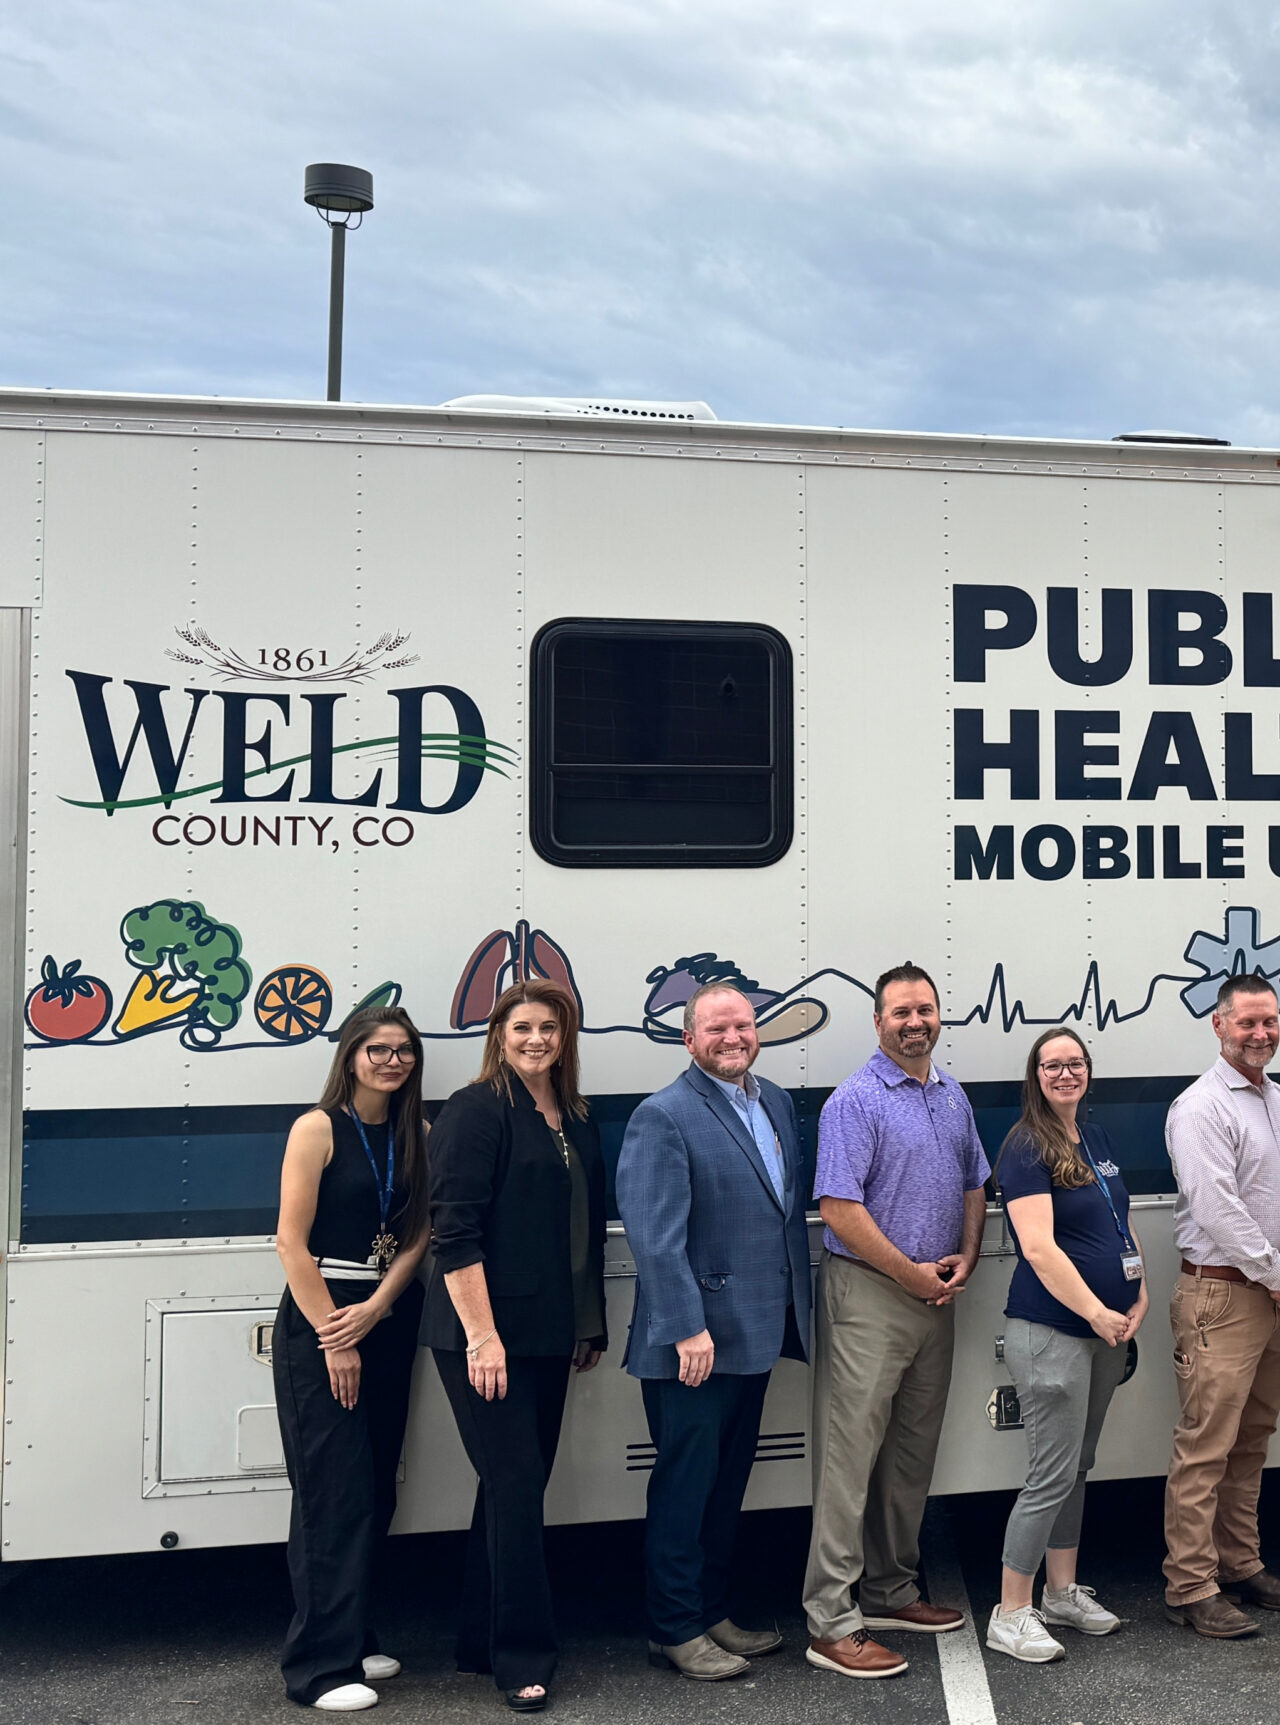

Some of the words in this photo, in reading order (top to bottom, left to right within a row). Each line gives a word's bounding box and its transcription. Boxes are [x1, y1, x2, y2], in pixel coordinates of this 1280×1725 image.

[258, 647, 329, 672] 1861
[65, 669, 487, 817] WELD
[152, 815, 341, 853] COUNTY,
[352, 815, 415, 847] CO
[954, 824, 1246, 881] MOBILE
